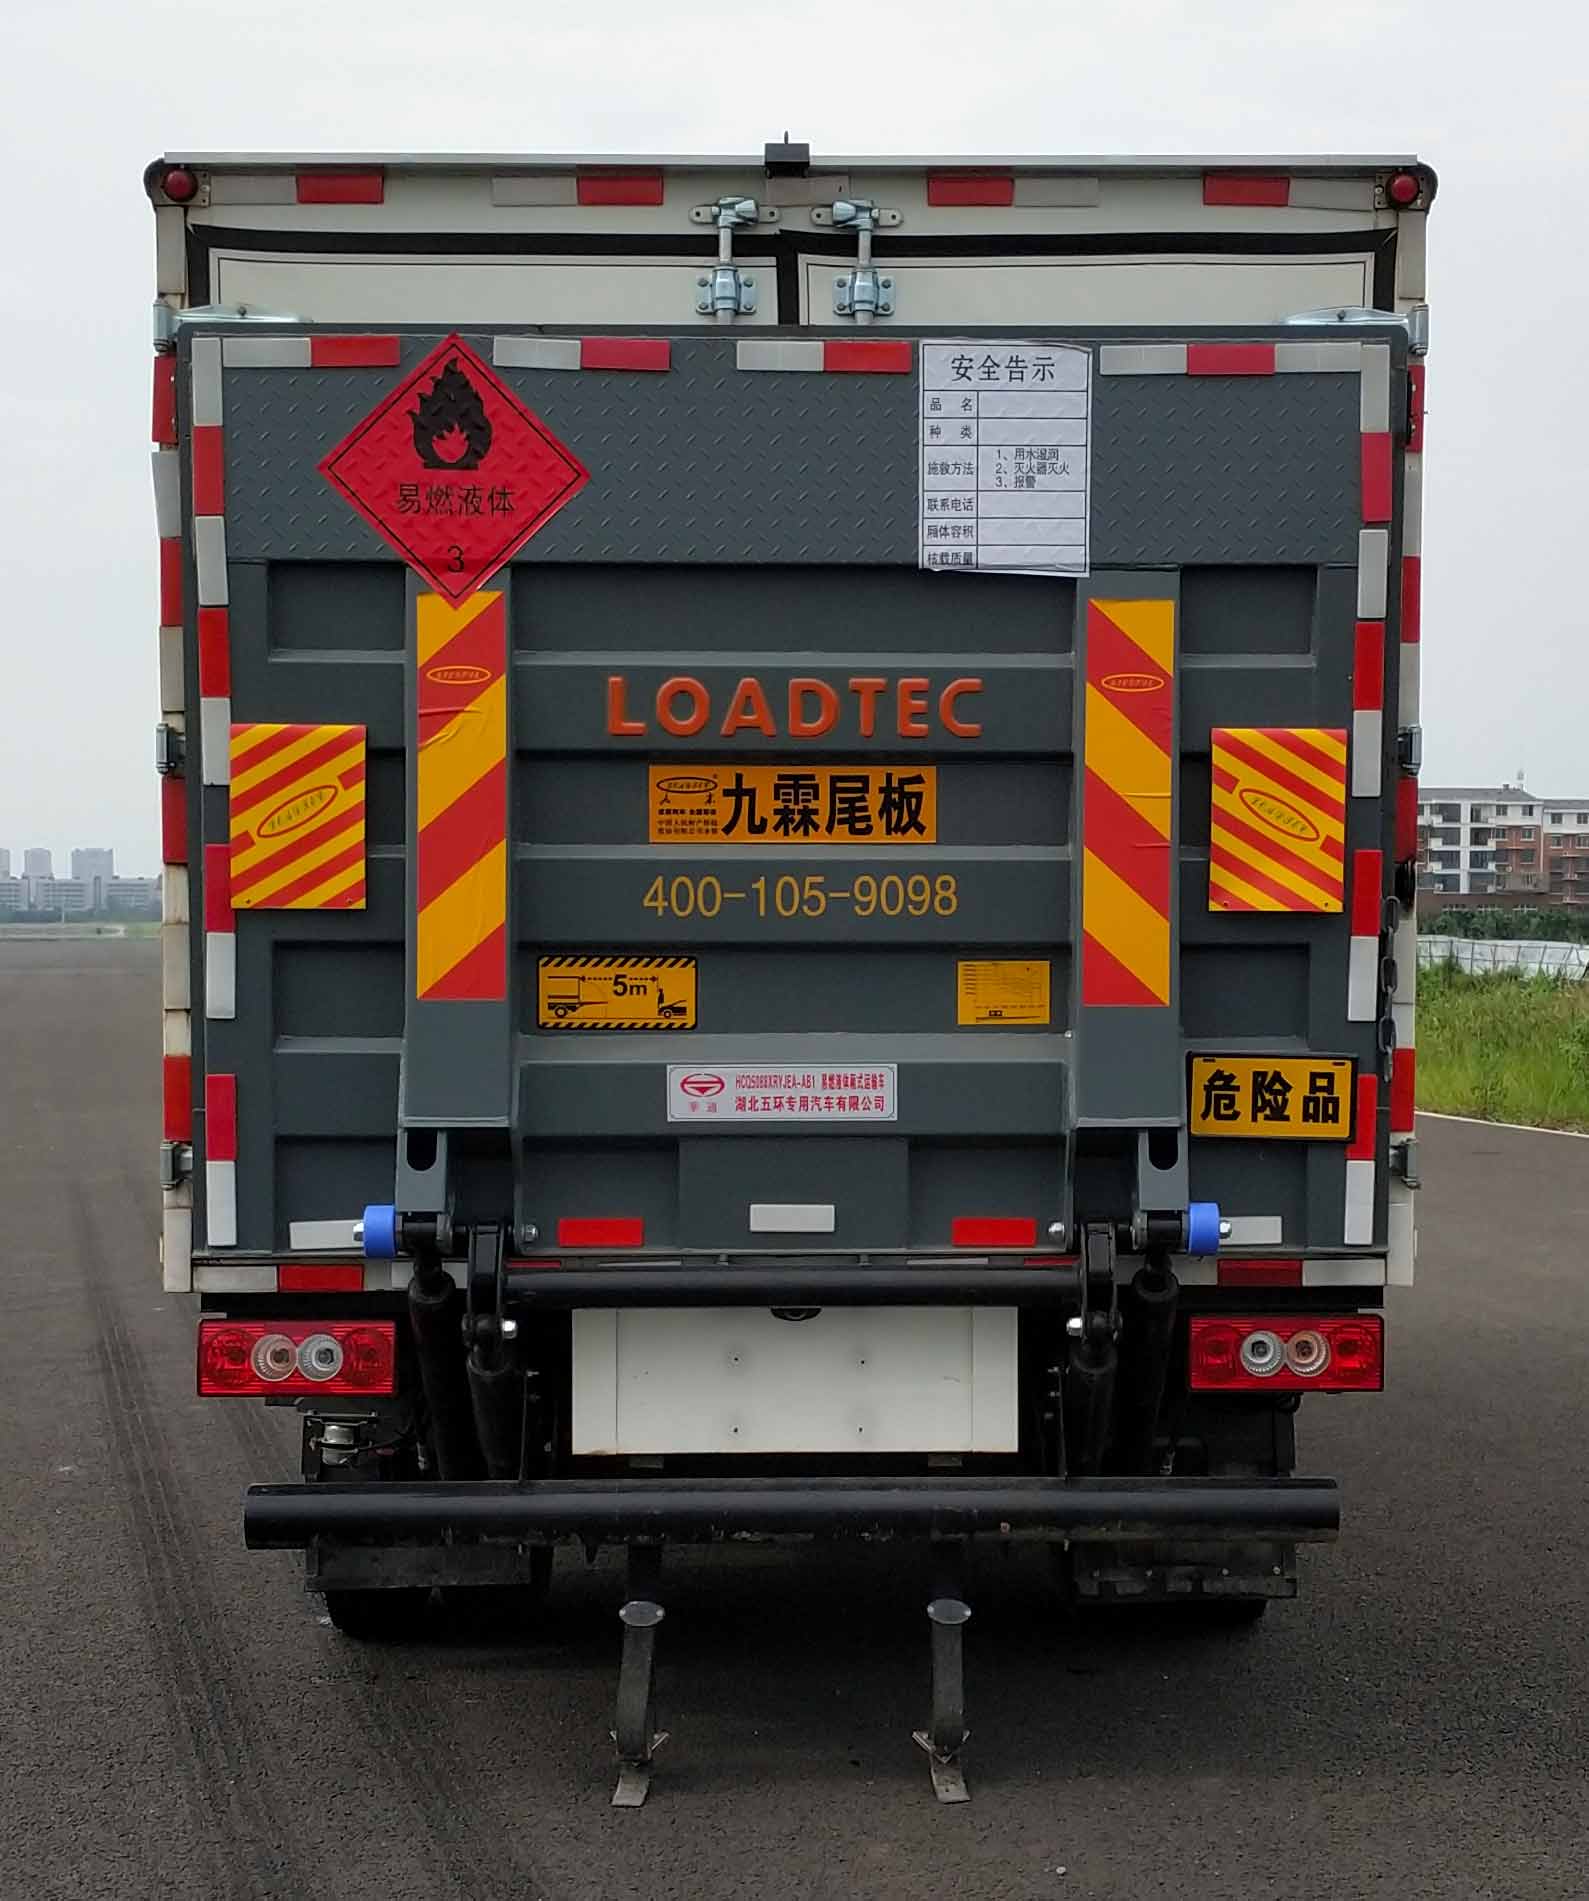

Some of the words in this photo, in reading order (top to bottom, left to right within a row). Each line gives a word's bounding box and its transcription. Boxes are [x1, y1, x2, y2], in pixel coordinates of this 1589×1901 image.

[951, 354, 1056, 382] 安全告示
[927, 461, 974, 476] 施救方法
[396, 483, 516, 516] 易燃液体
[927, 497, 974, 511] 联系电话
[447, 545, 465, 573] 3
[606, 675, 983, 738] LOADTEC
[720, 772, 928, 837] 九霖尾板
[642, 874, 959, 917] 400-105-9098
[612, 974, 648, 997] 5m
[735, 1095, 885, 1113] 湖北五环专用汽车有限公司
[1200, 1068, 1340, 1124] 危险品
